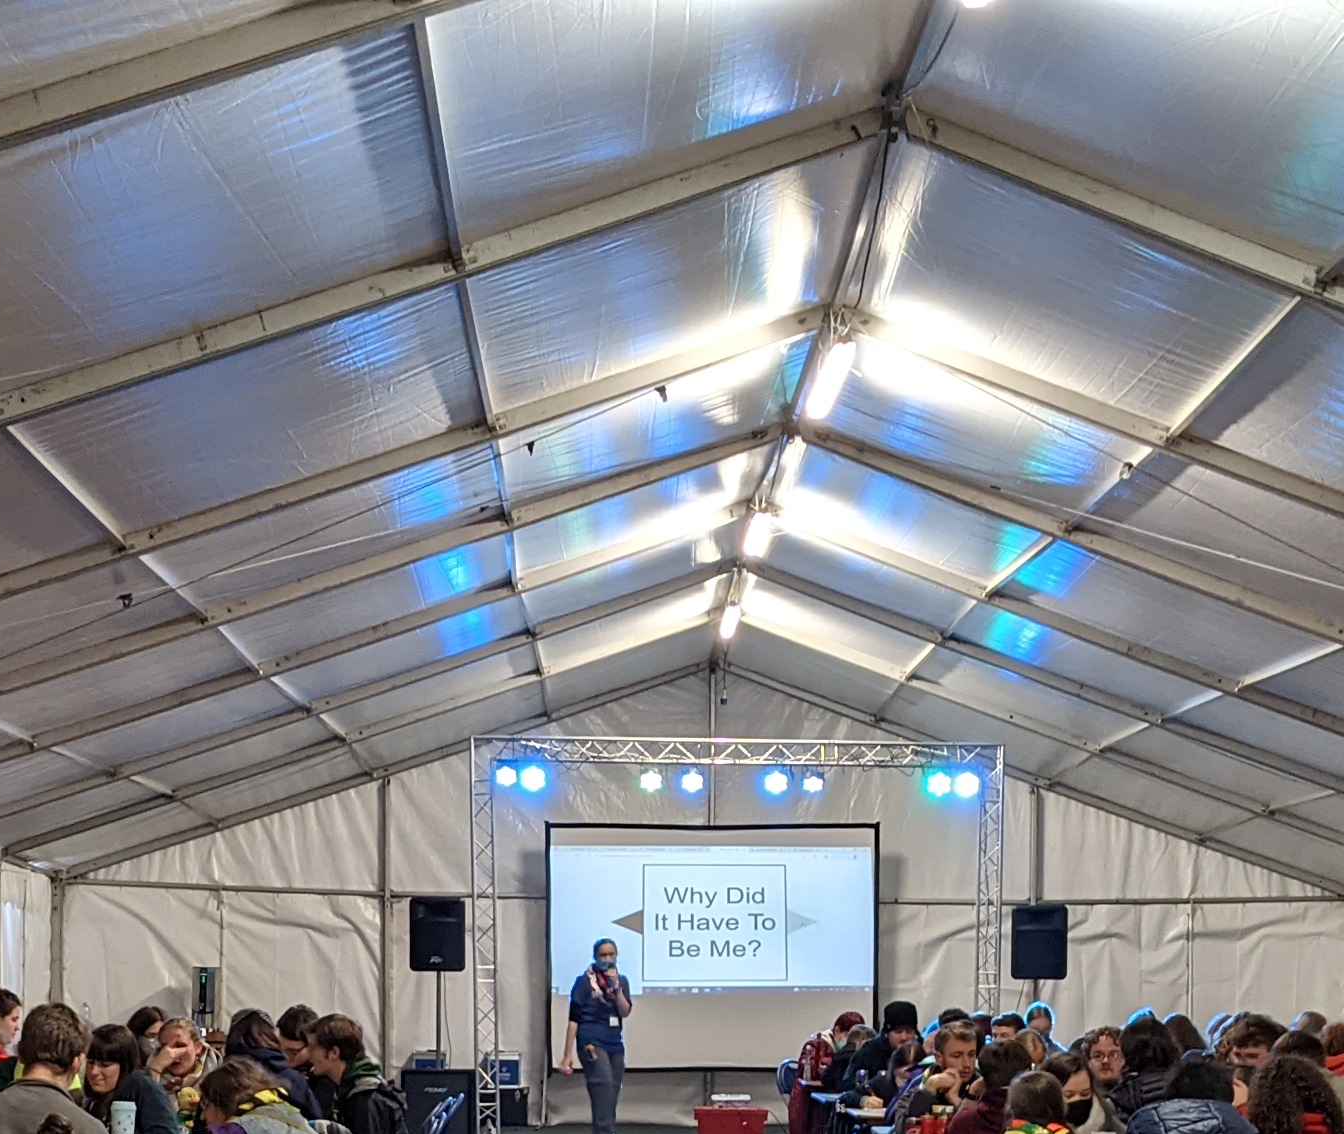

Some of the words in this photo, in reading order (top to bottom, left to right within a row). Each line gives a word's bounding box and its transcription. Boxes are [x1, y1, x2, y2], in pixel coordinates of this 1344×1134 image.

[663, 886, 718, 908] Why
[726, 886, 765, 904] Did
[655, 913, 669, 931] It
[677, 913, 740, 931] Have
[747, 913, 776, 931] To
[668, 940, 701, 957] Be
[710, 939, 761, 957] Me?
